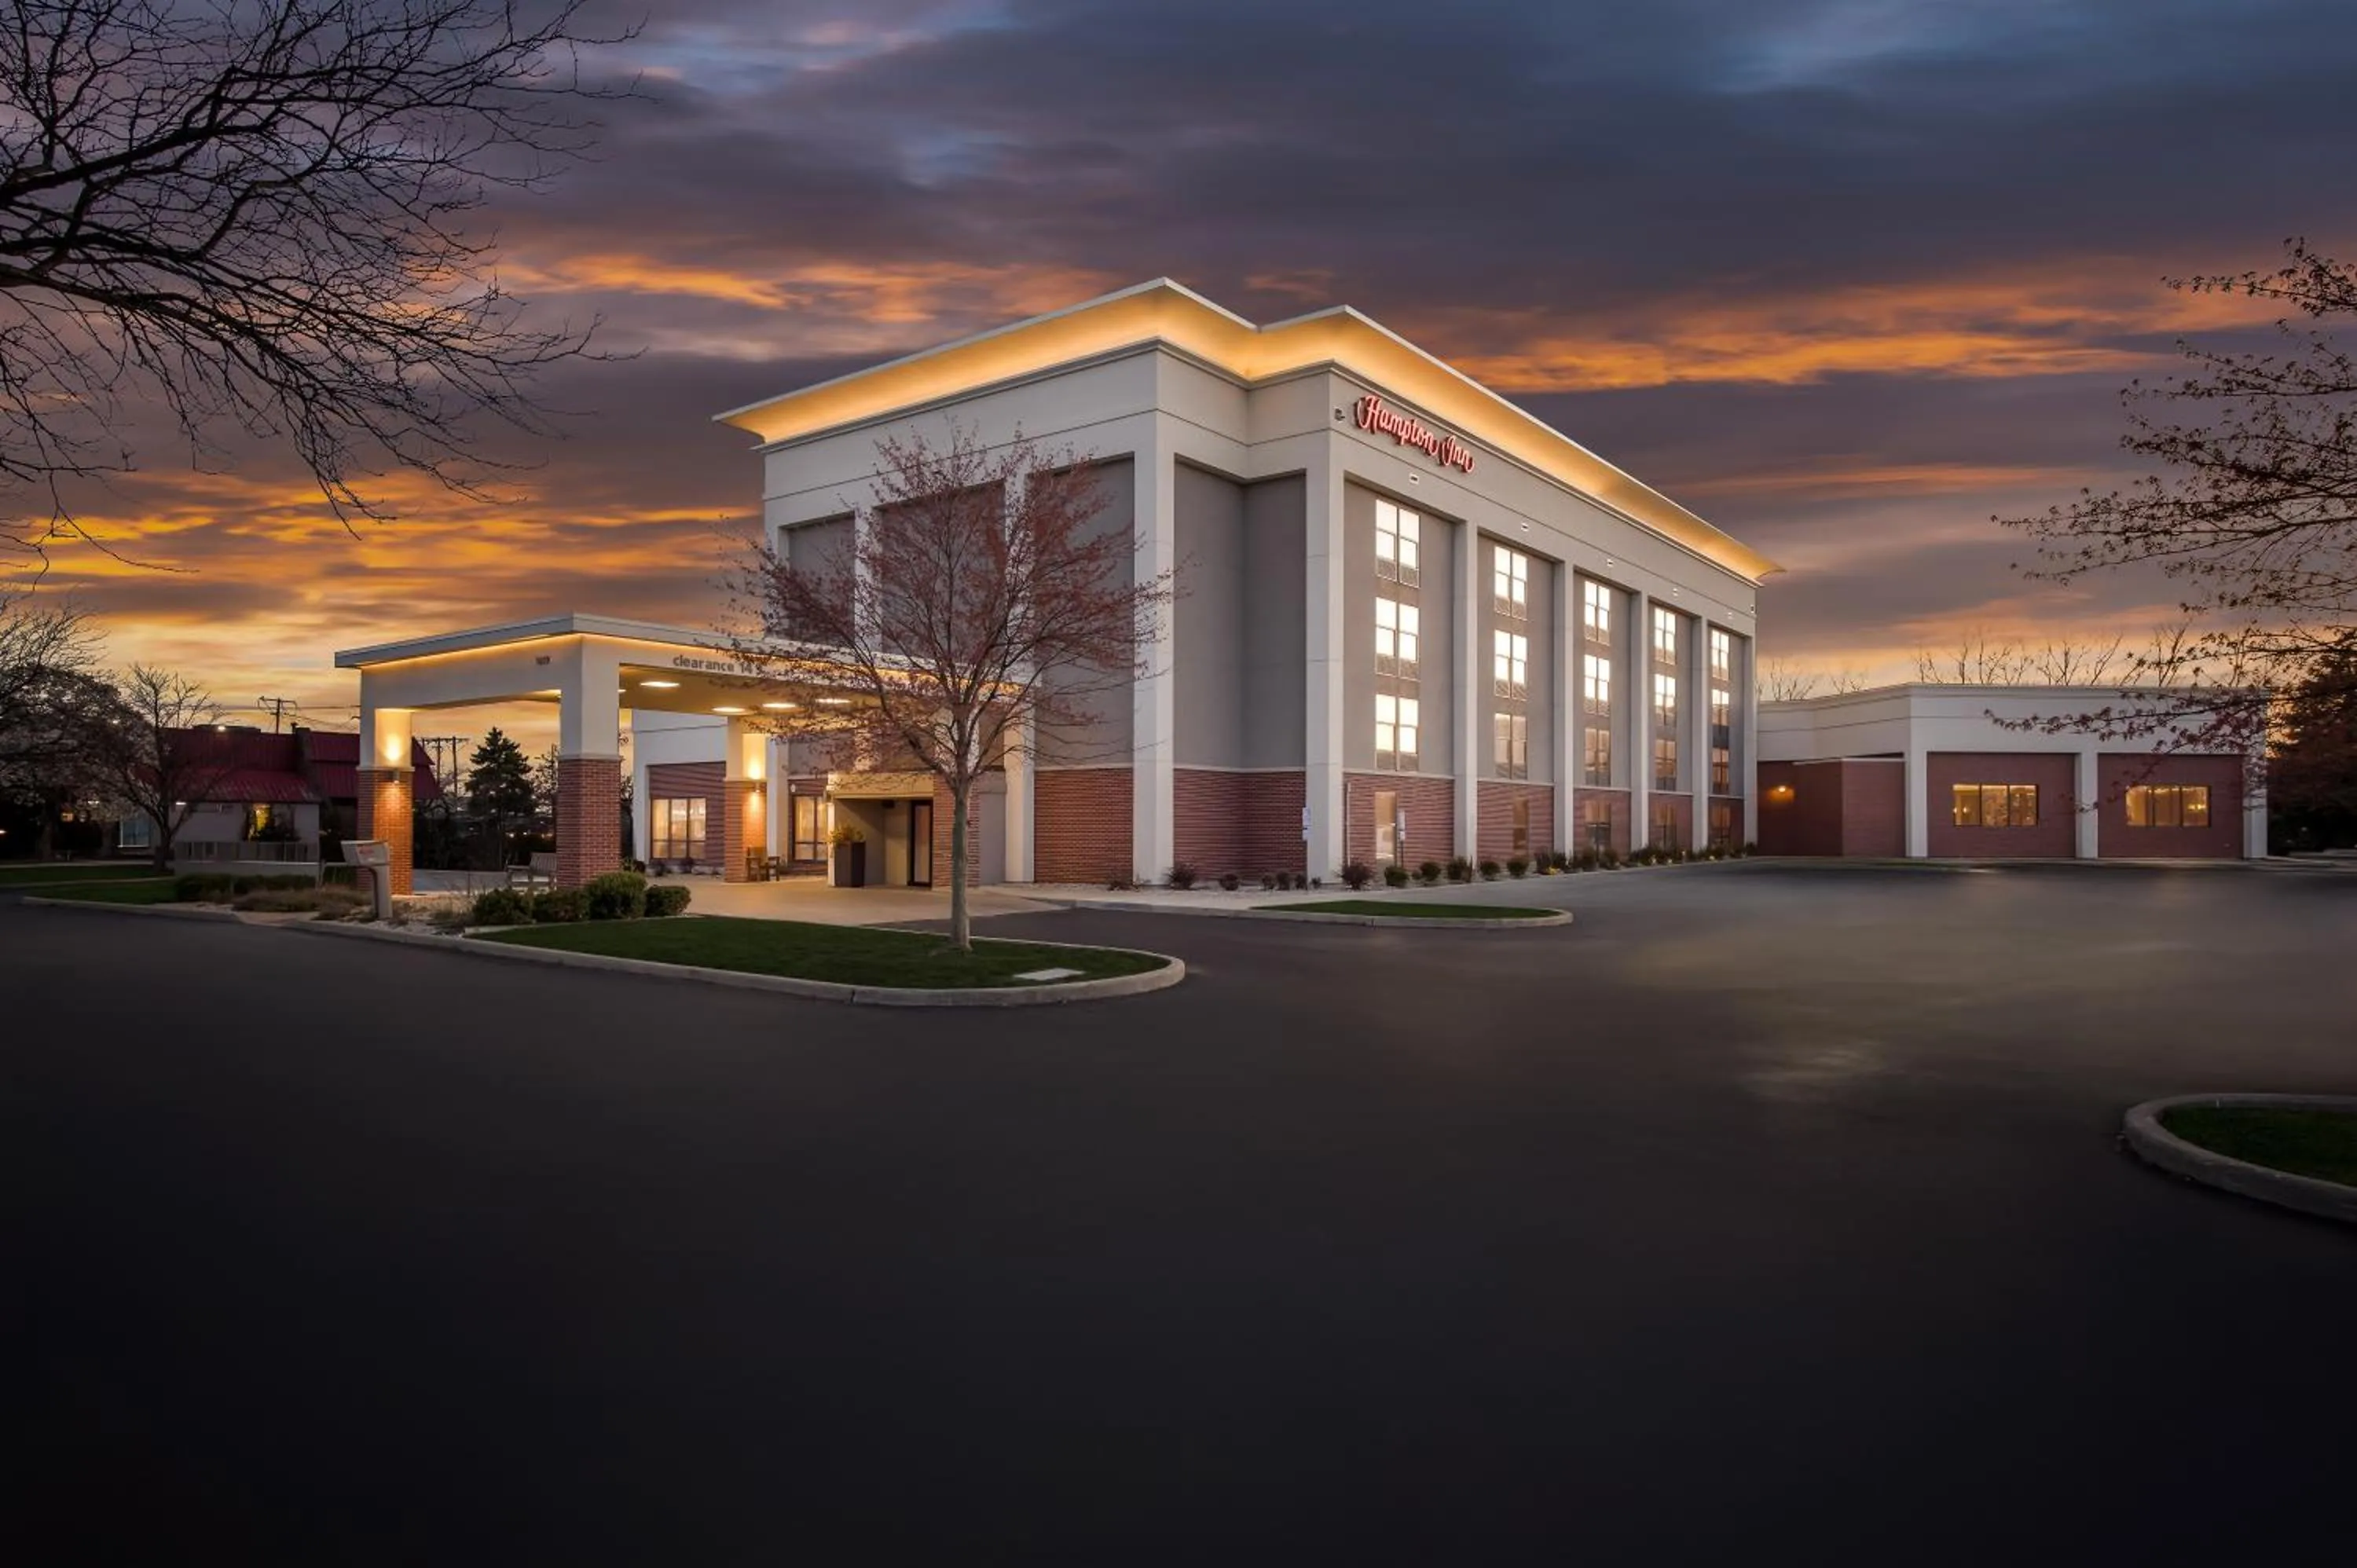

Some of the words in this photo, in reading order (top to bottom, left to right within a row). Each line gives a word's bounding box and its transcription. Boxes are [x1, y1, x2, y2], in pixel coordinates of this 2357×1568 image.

[1355, 395, 1439, 456] Hampton
[1441, 434, 1475, 473] Inn
[673, 654, 735, 672] clearance
